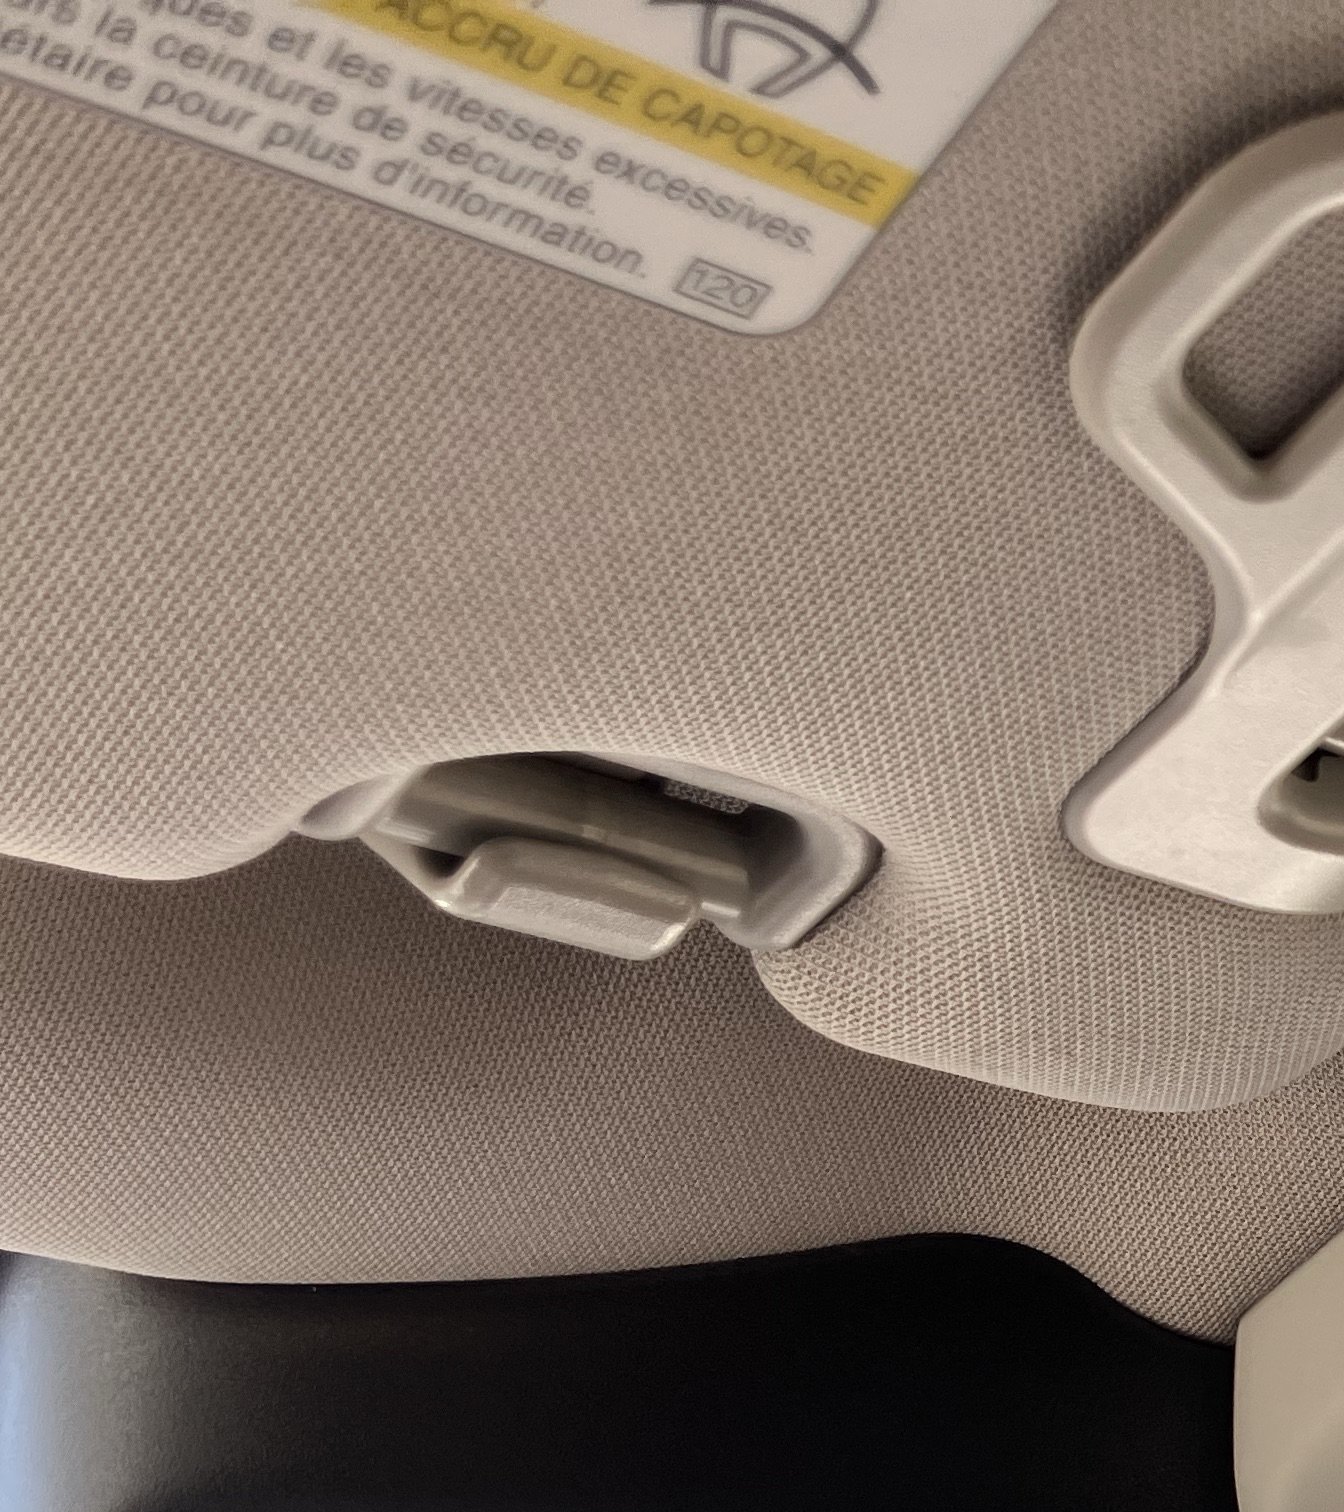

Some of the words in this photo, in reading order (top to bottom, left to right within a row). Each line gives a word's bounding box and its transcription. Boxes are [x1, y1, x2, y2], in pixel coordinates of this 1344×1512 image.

[95, 5, 138, 45] la
[153, 32, 341, 117] ceinture
[352, 104, 409, 142] de
[419, 131, 597, 215] sécurité.
[142, 79, 257, 133] pour
[259, 121, 362, 172] plus
[372, 154, 647, 279] d'information.
[267, 26, 318, 62] et
[323, 37, 393, 89] les
[406, 76, 584, 162] vitesses
[593, 146, 814, 256] excessives.
[561, 53, 638, 106] DE
[641, 87, 886, 206] CAPOTAGE
[694, 267, 757, 309] 120
